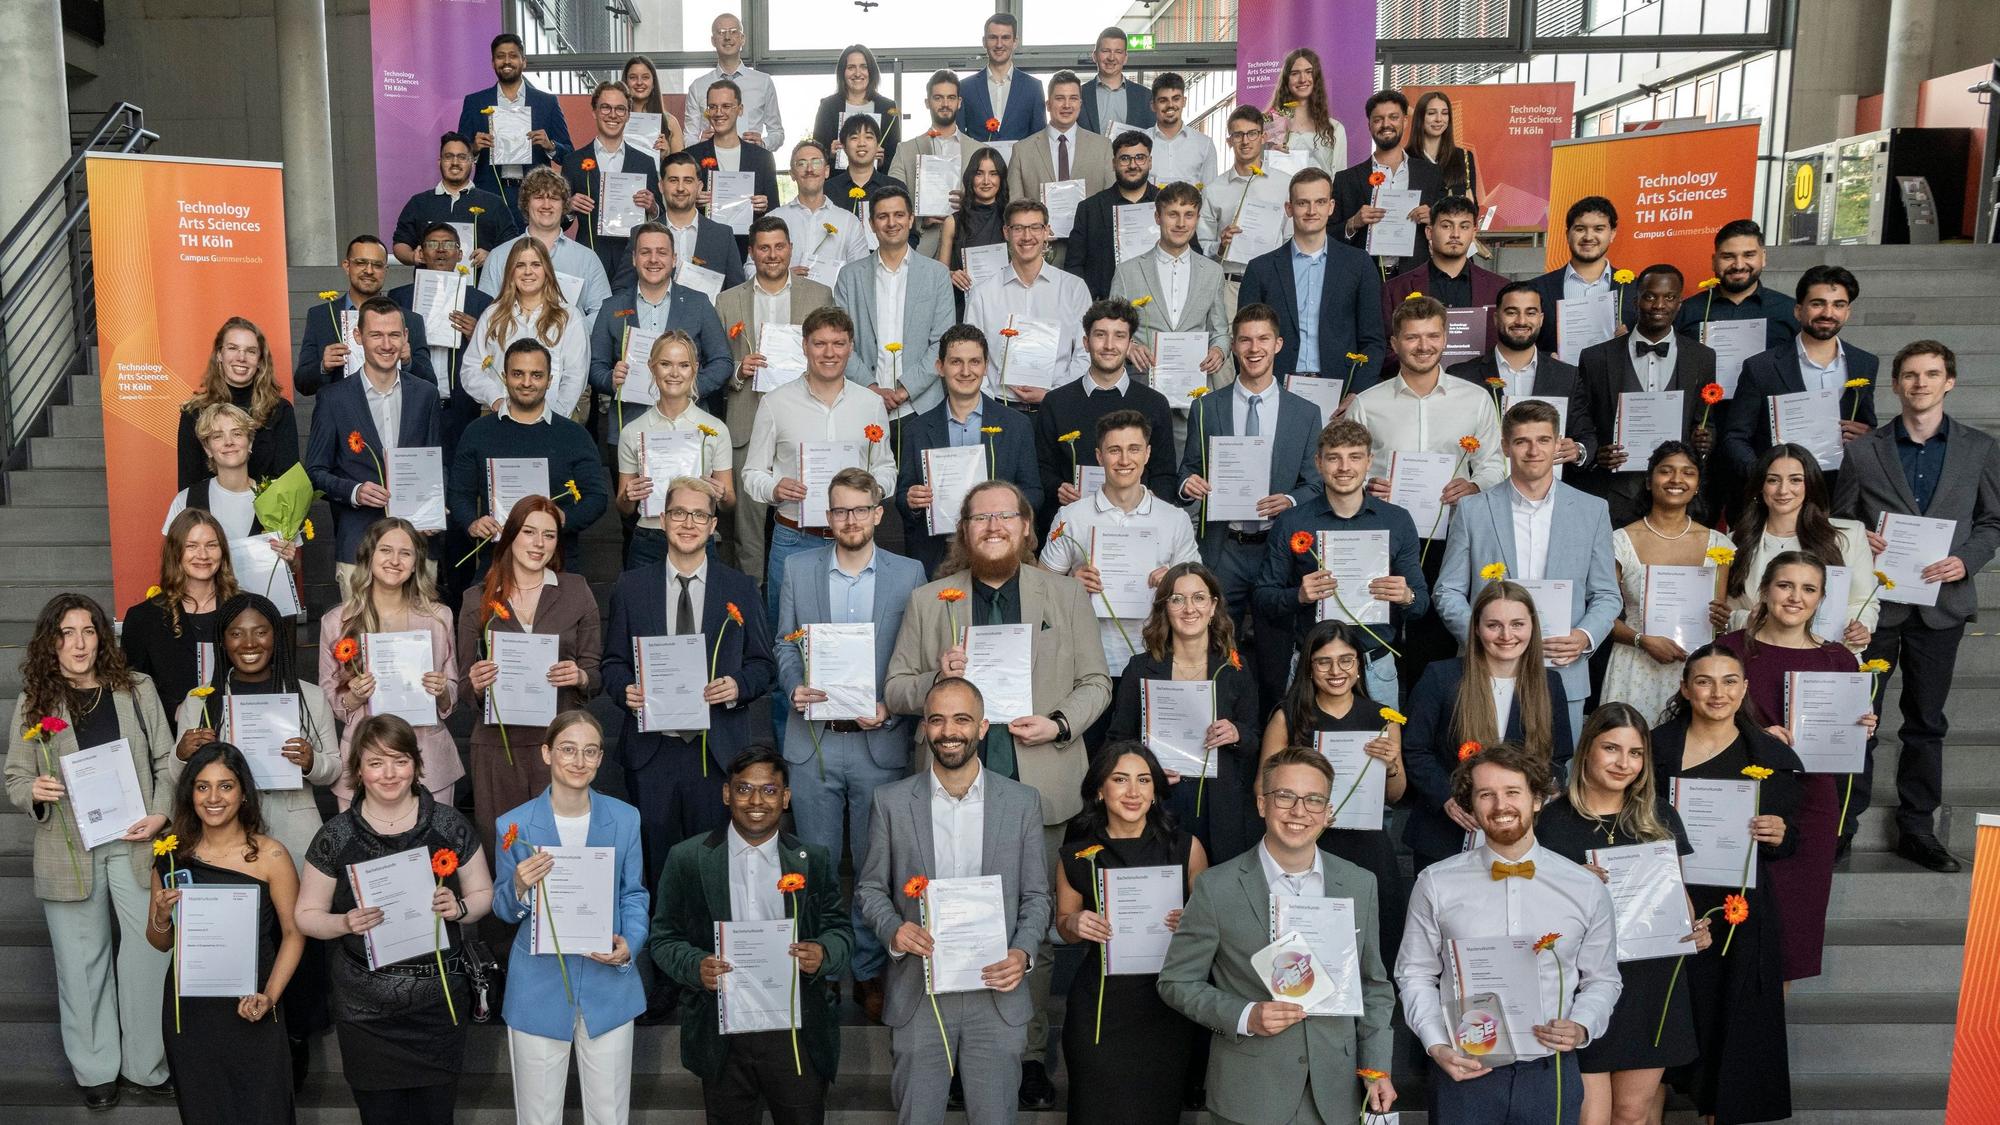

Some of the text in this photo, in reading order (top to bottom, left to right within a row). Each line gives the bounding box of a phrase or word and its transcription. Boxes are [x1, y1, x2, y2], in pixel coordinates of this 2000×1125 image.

[384, 70, 415, 79] Technology
[1510, 104, 1557, 115] Technology
[1509, 114, 1563, 124] Arts Sciences
[1509, 125, 1544, 135] TH Köln
[1638, 171, 1718, 189] Technology
[1636, 188, 1728, 206] Arts Sciences
[177, 200, 251, 219] Technology
[1635, 207, 1694, 224] TH Köln
[179, 216, 262, 232] Arts Sciences
[1633, 225, 1723, 240] Campus Gummersbac
[179, 234, 234, 249] TH Köln
[180, 253, 263, 265] Campus Gummersbach
[117, 363, 163, 373] Technology
[118, 373, 135, 381] Arts
[119, 383, 131, 391] TH
